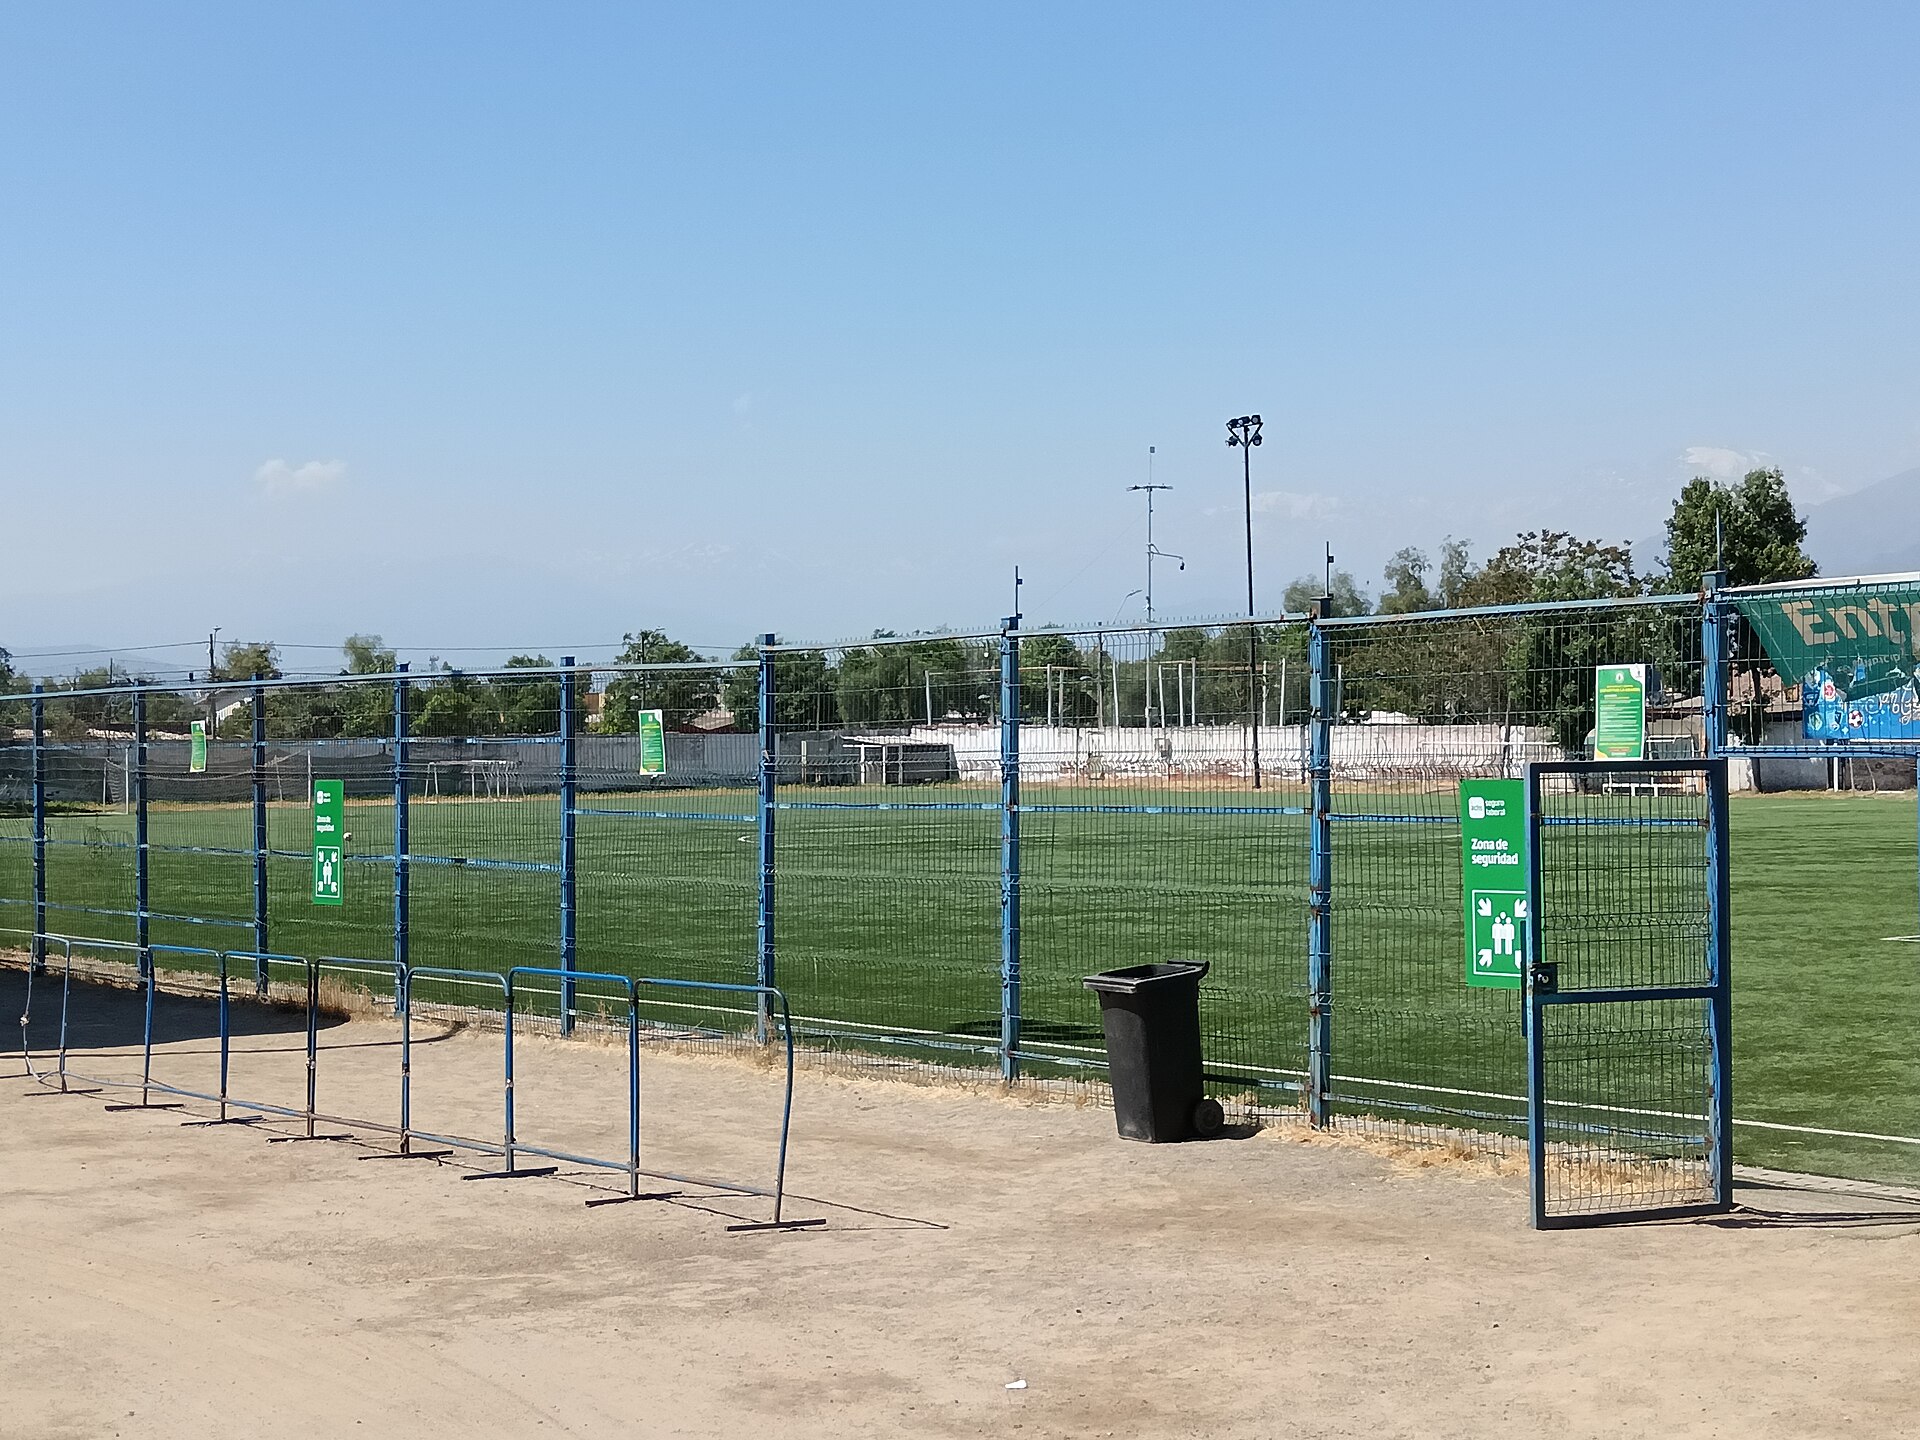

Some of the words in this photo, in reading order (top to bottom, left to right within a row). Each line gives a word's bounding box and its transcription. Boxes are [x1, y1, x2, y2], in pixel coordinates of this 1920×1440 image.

[1471, 838, 1495, 850] Zona
[1495, 838, 1508, 850] de
[1471, 852, 1519, 867] seguridad
